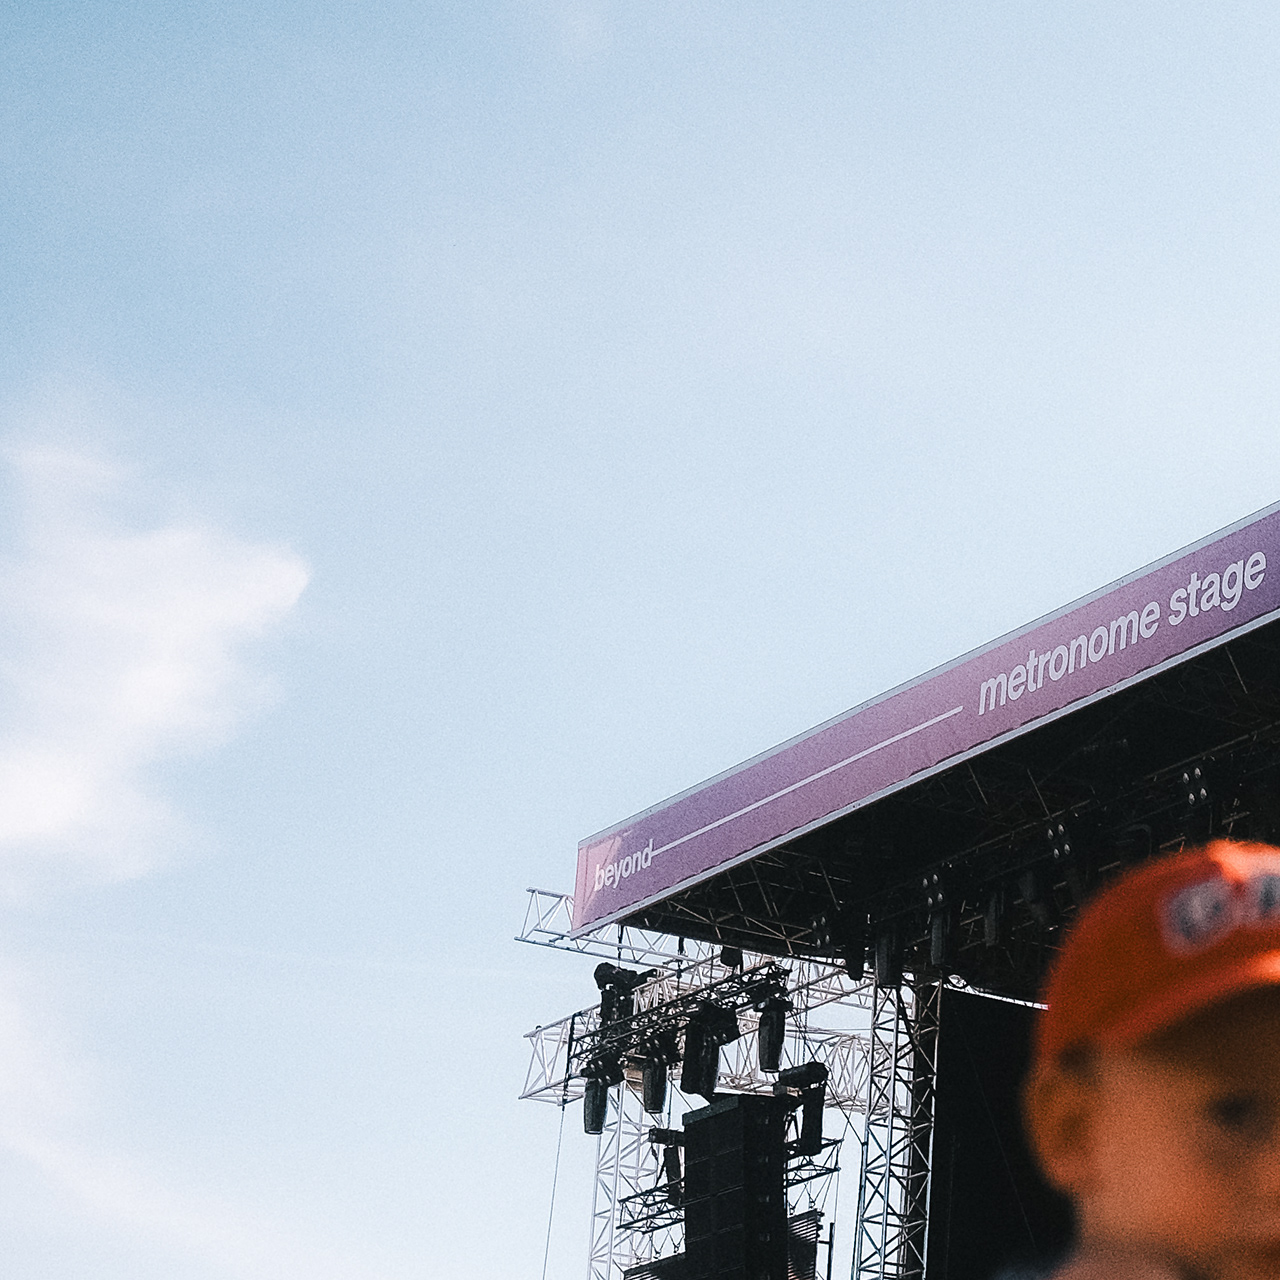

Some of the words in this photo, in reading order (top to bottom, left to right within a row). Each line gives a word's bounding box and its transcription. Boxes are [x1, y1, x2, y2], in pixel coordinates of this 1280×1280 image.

[594, 838, 654, 892] beyond
[978, 601, 1161, 715] metronome
[1168, 551, 1267, 626] stage
